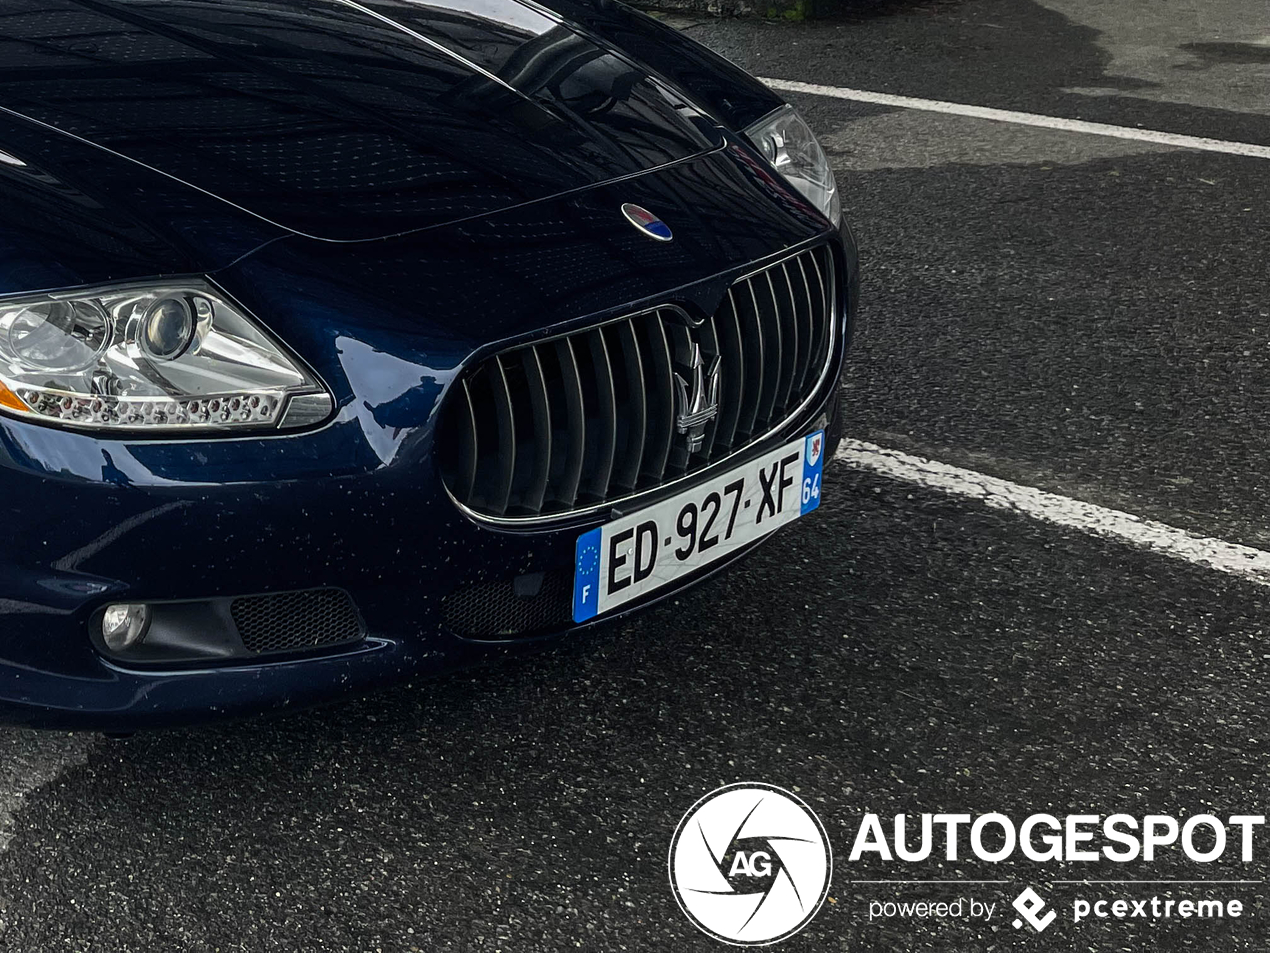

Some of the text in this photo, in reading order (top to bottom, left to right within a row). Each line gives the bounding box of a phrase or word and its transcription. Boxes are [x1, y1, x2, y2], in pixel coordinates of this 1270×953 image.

[582, 451, 800, 604] F ED-927-XF
[802, 473, 819, 505] 64
